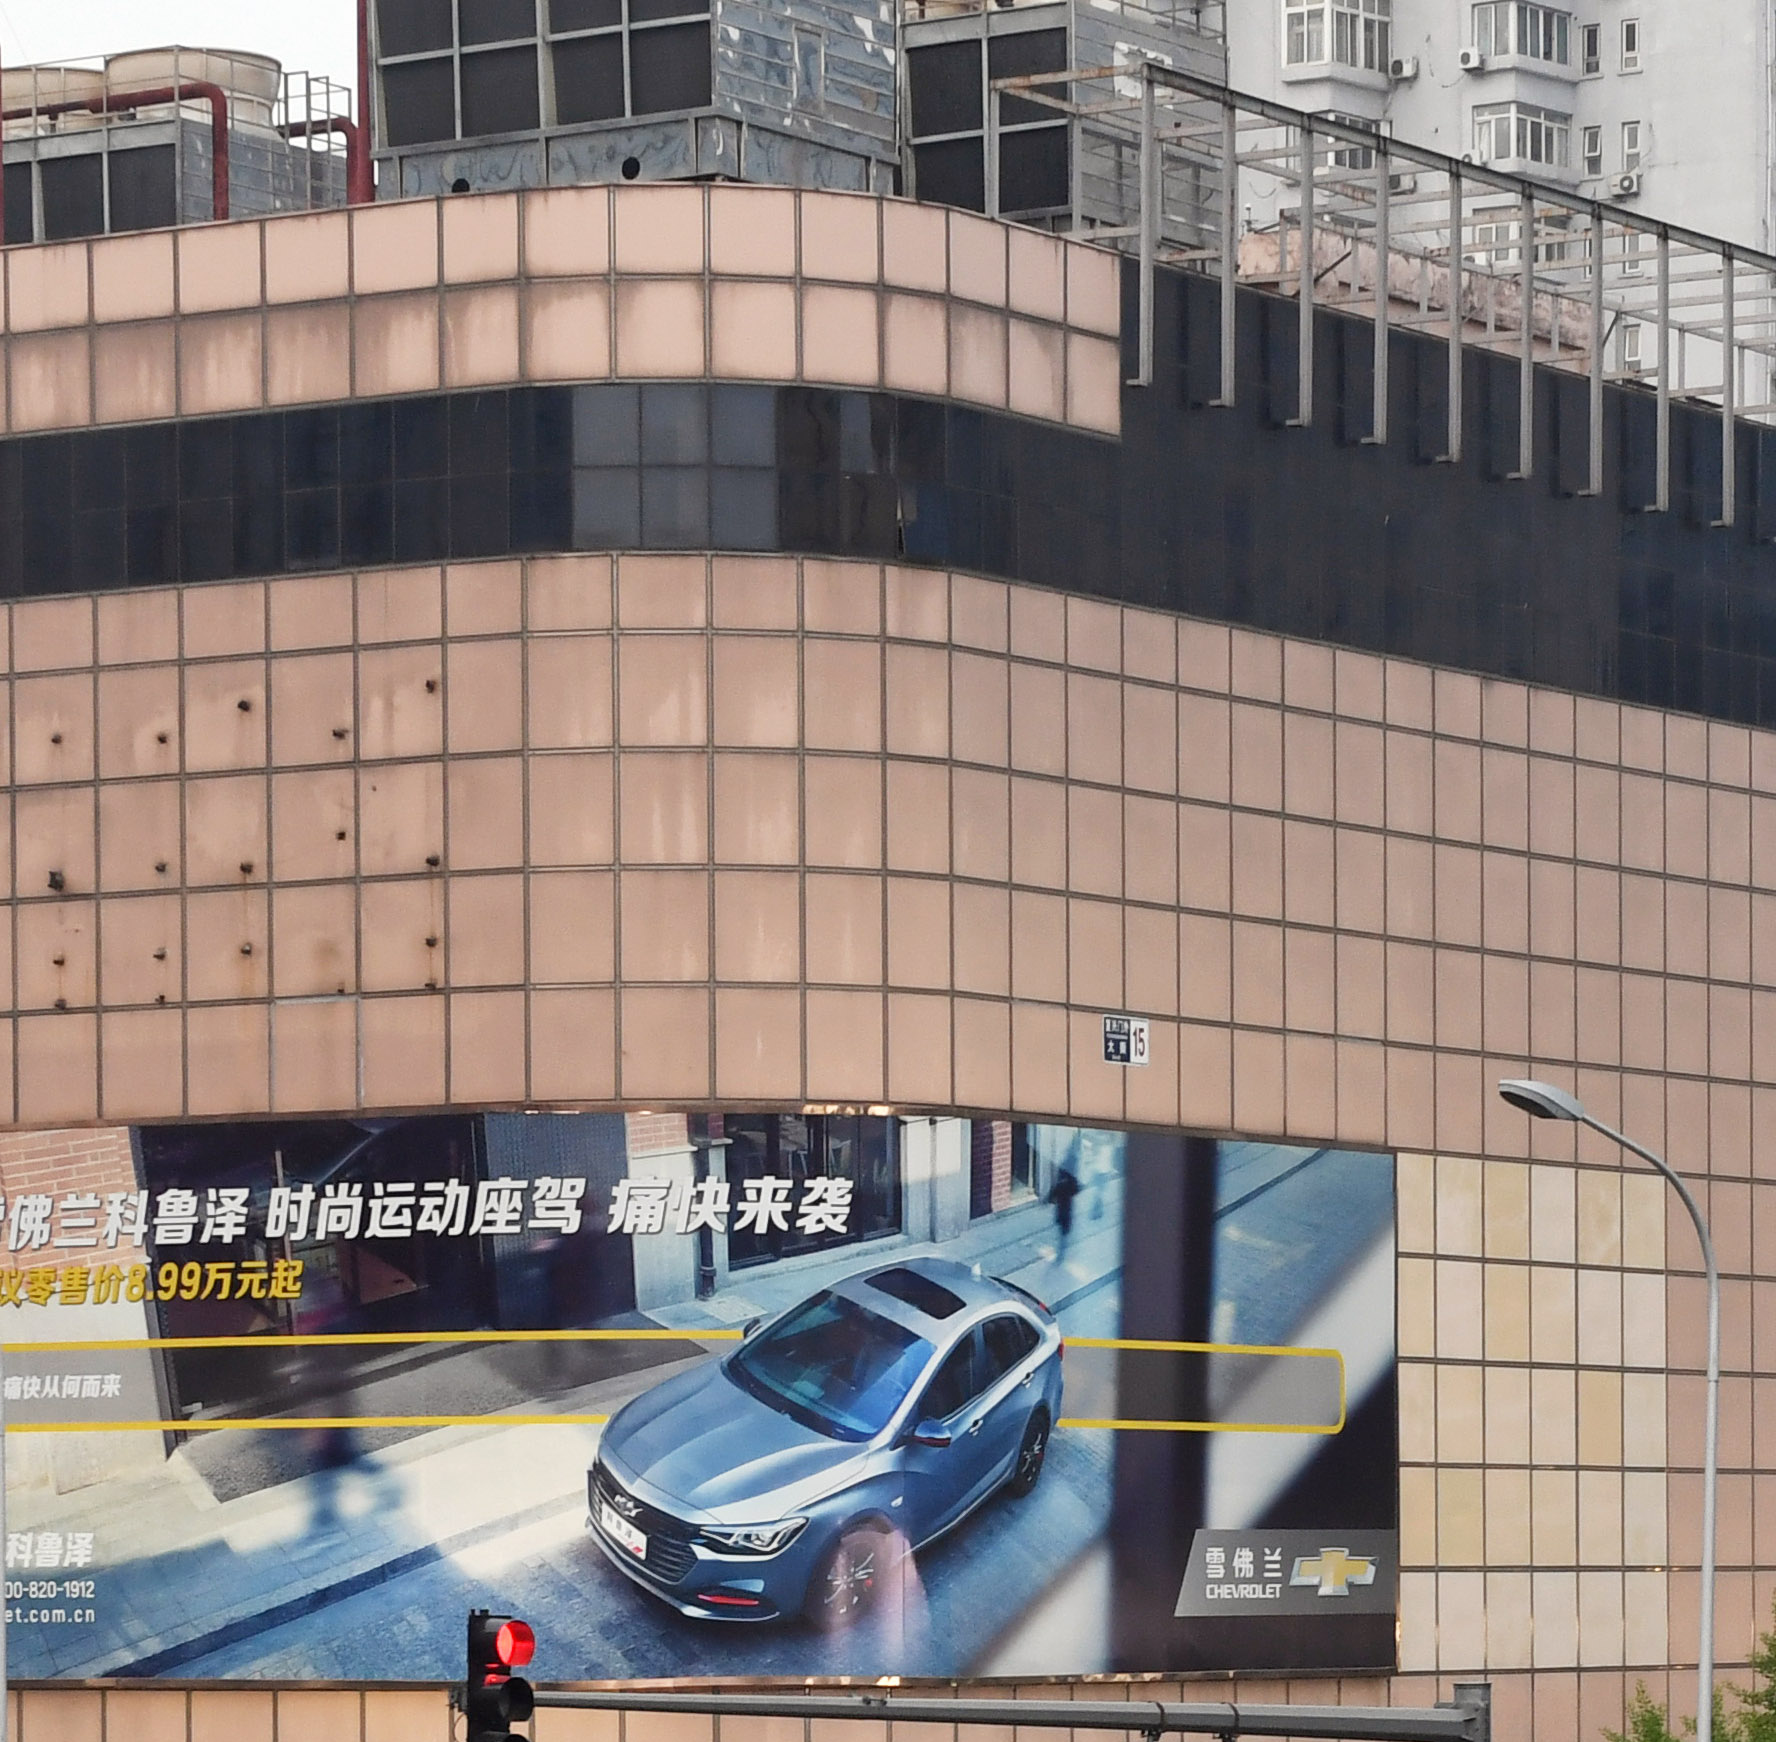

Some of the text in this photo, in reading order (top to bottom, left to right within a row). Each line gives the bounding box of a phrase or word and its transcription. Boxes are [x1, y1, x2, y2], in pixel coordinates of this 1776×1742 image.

[1133, 1027, 1146, 1057] 15
[264, 1176, 584, 1240] 时尚运动座驾
[607, 1175, 856, 1237] 痛快来袭
[2, 1373, 122, 1401] 痛快从何而来
[5, 1531, 95, 1568] 科鲁泽
[1204, 1544, 1283, 1582] 雪佛兰
[0, 1580, 95, 1599] 00-820-1912
[1204, 1583, 1282, 1601] CHEVROLET
